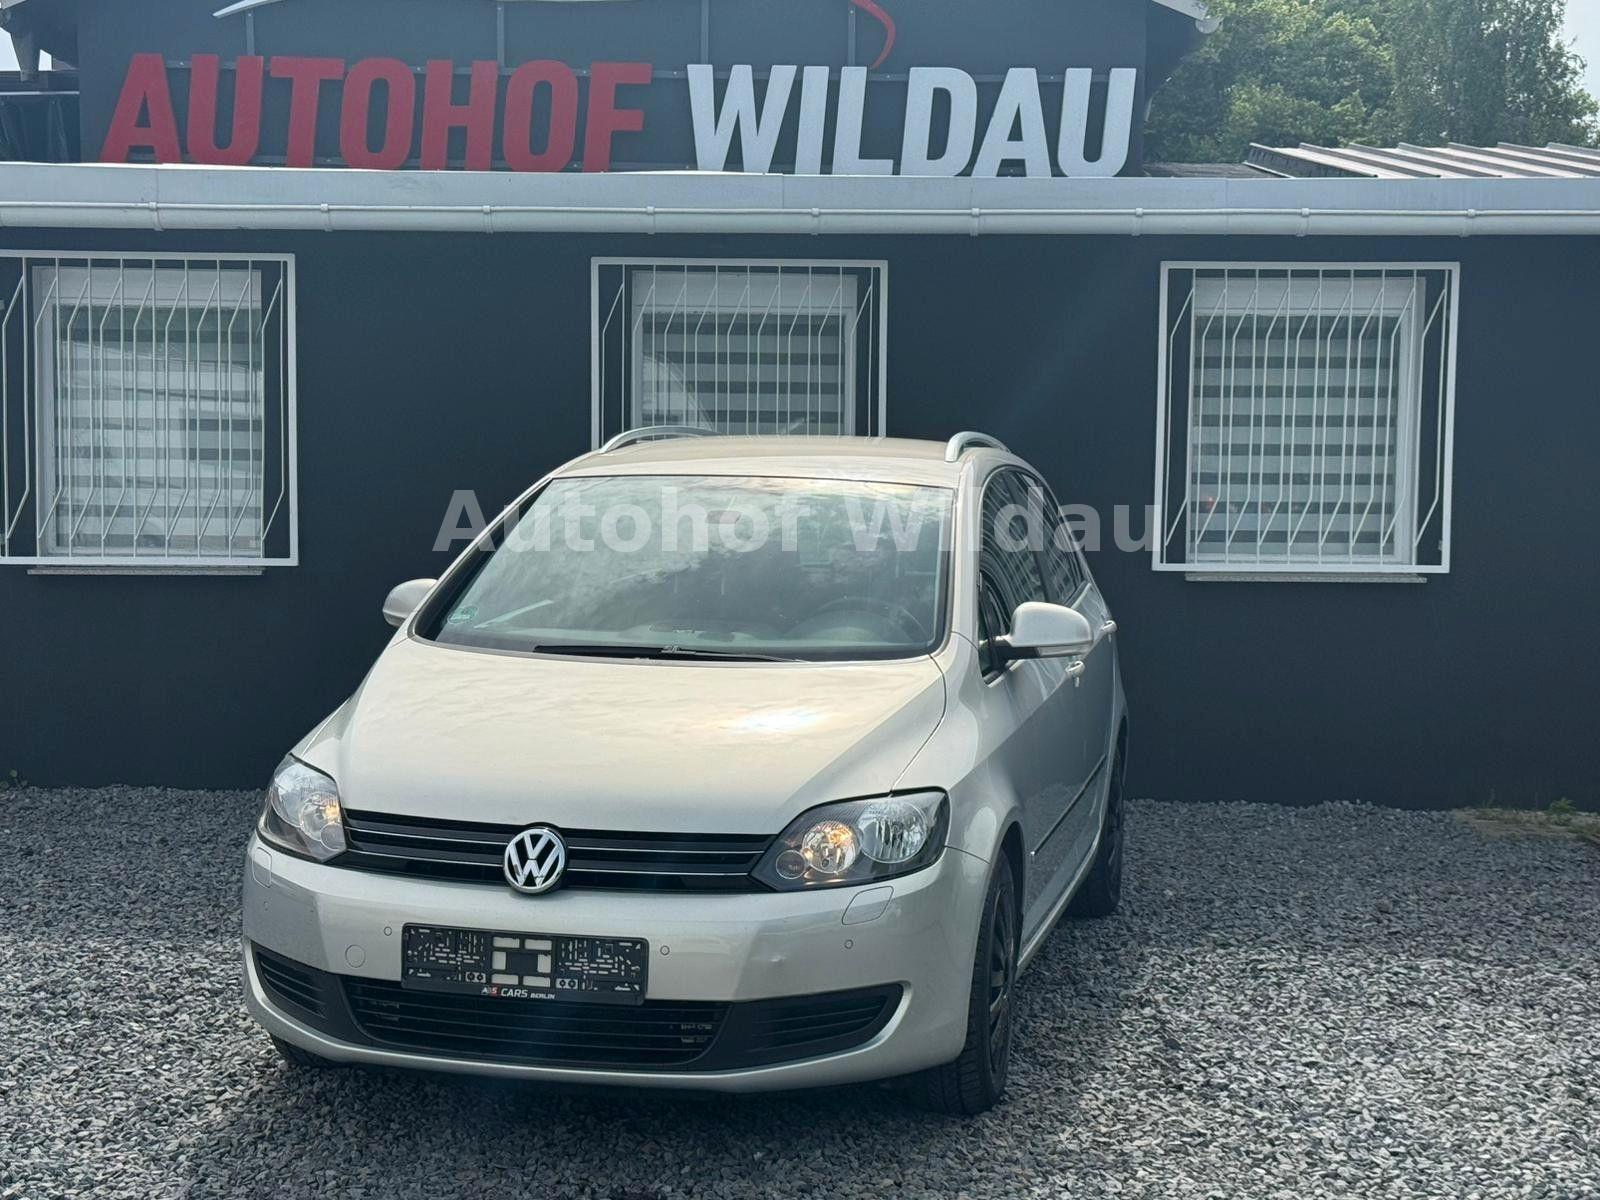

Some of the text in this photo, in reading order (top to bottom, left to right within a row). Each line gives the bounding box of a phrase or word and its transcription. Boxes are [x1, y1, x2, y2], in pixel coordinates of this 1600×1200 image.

[101, 53, 1137, 177] AUTOHOF WILDAU
[506, 827, 563, 889] VW
[501, 988, 529, 998] CARS
